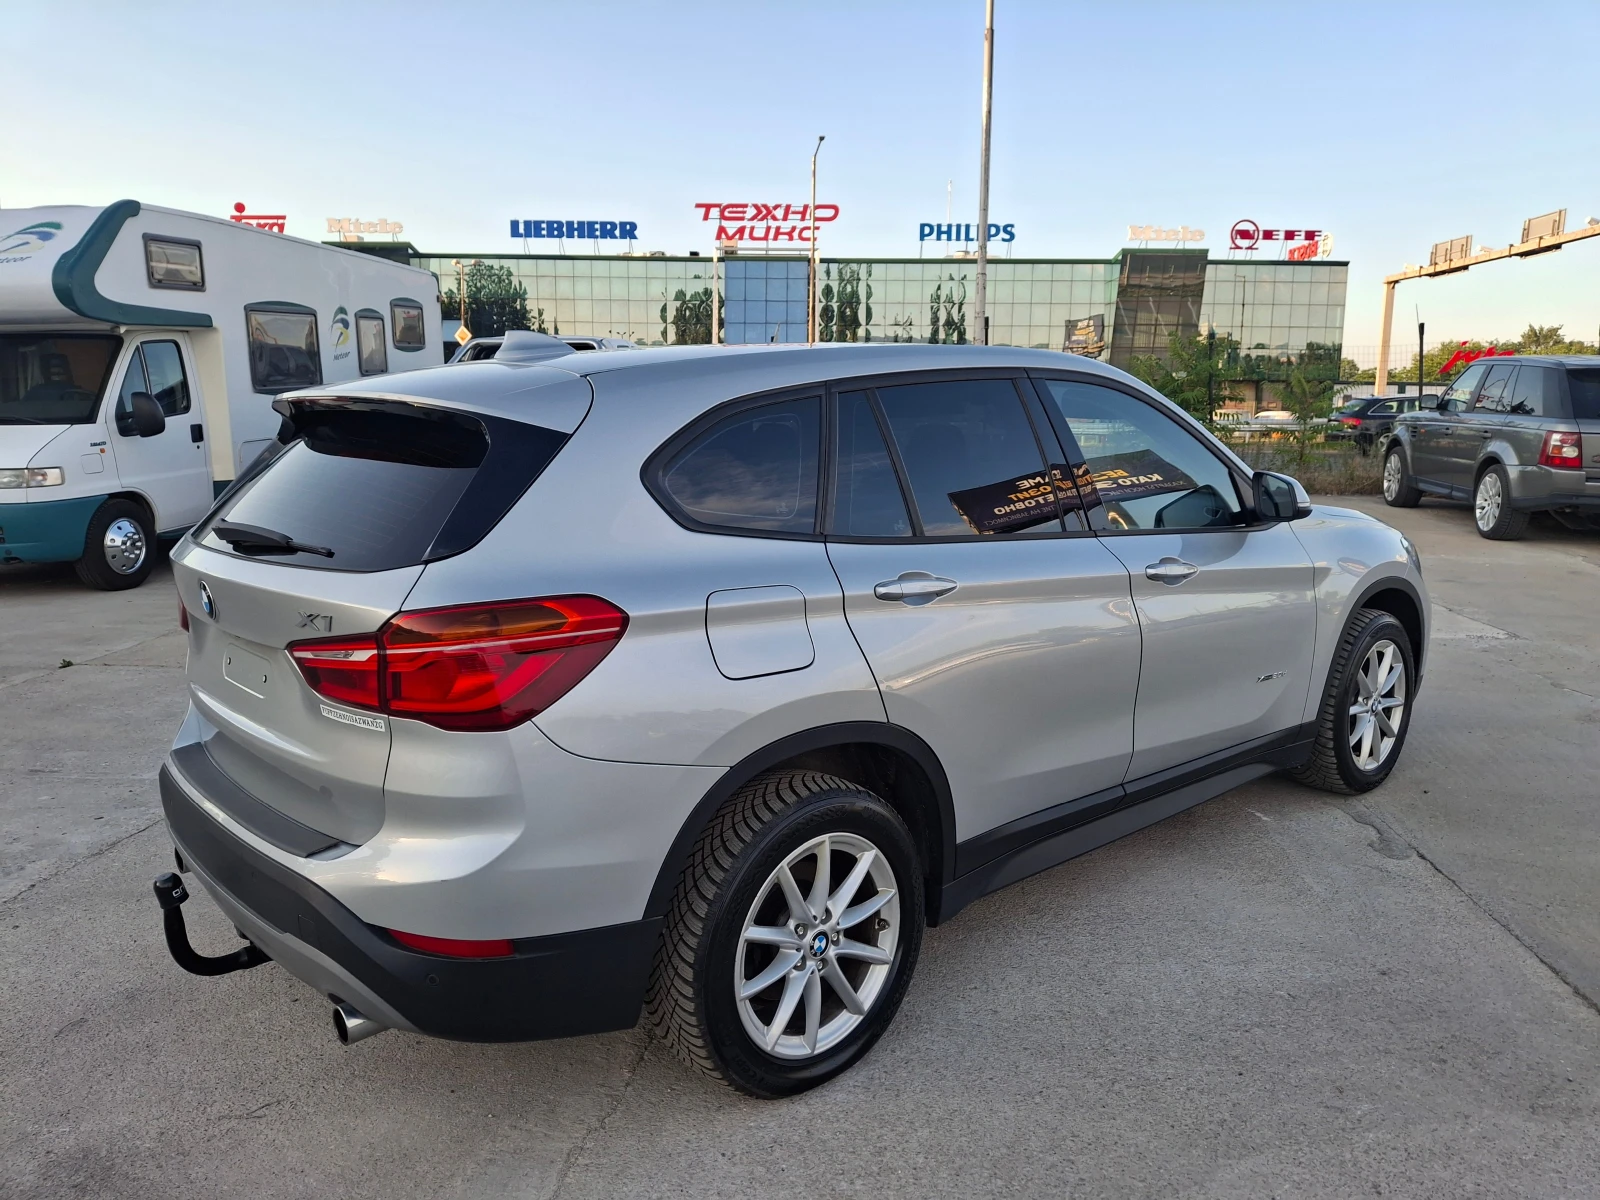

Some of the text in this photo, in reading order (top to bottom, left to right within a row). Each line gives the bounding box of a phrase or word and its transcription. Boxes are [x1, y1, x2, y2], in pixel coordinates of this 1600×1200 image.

[326, 217, 403, 234] Miele
[510, 219, 638, 240] LIEBHERR
[1127, 225, 1205, 242] Miele
[295, 611, 333, 632] X1
